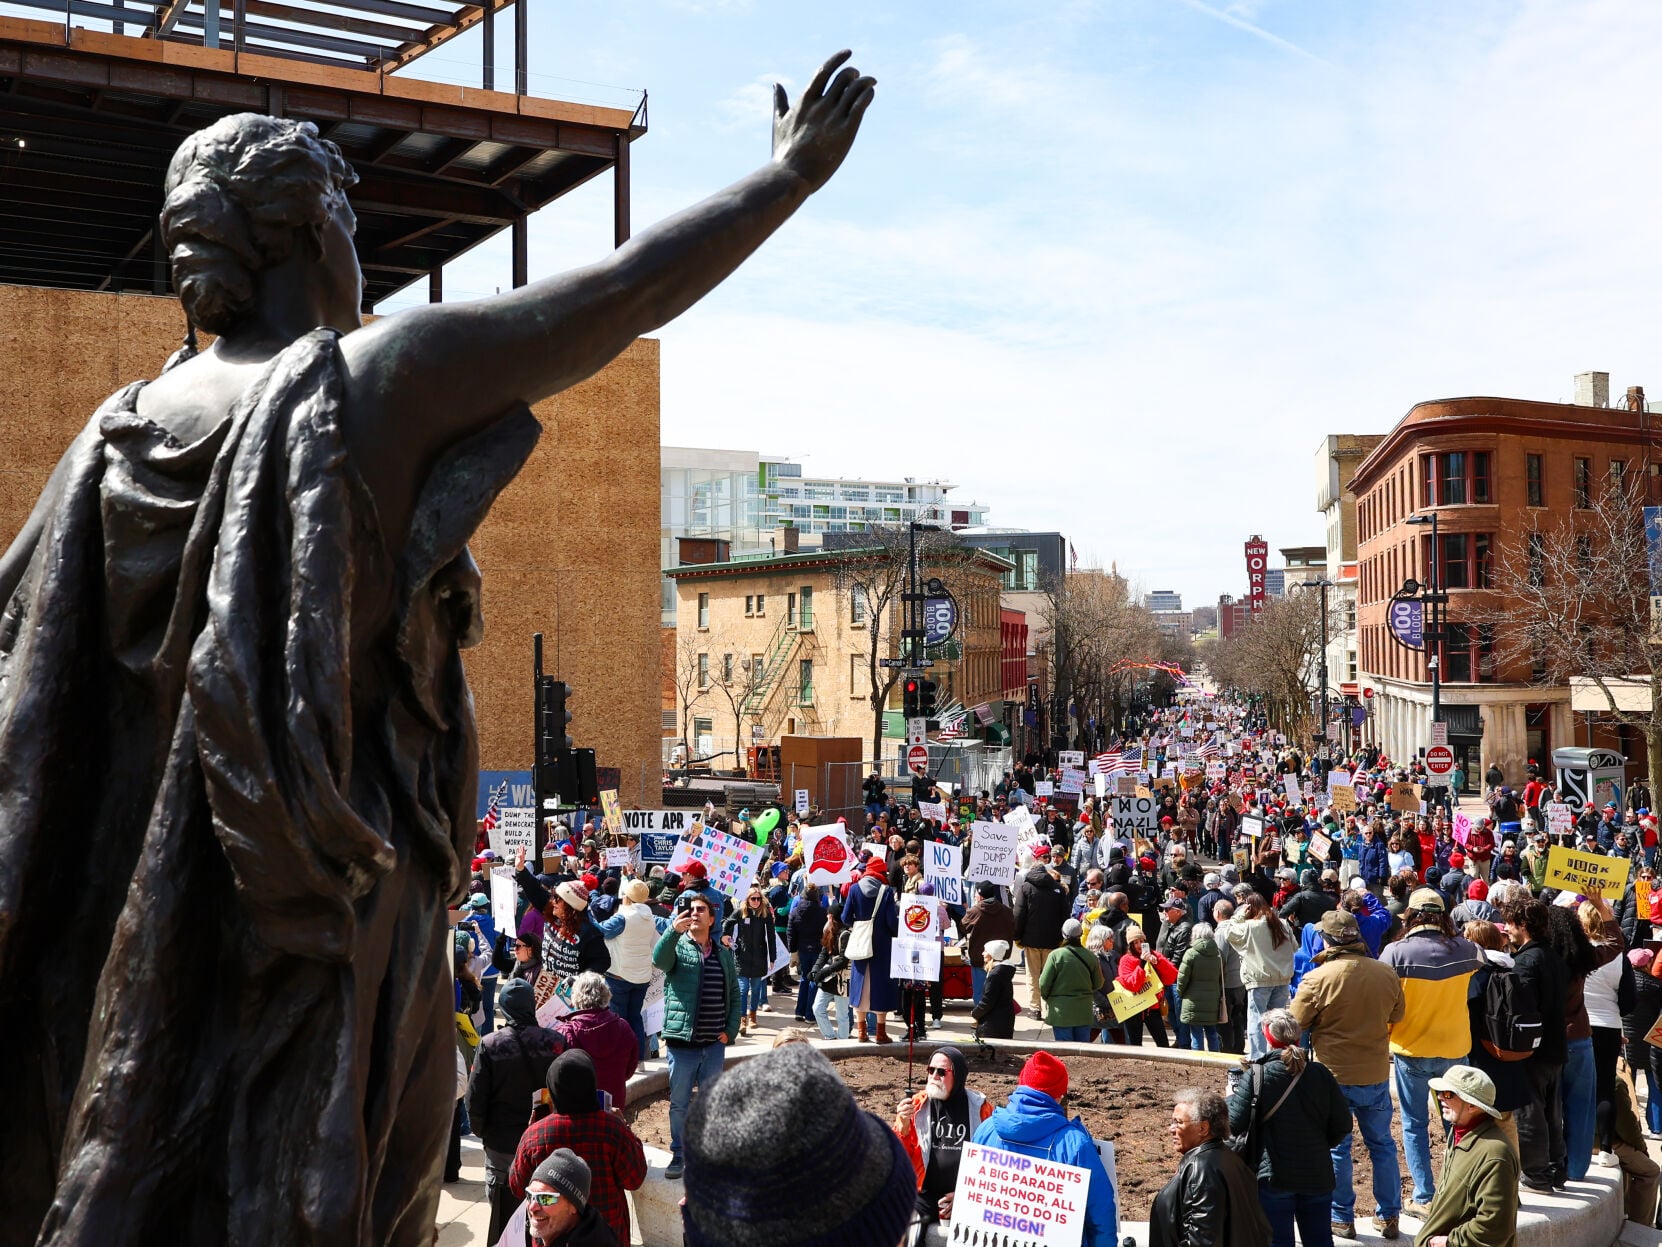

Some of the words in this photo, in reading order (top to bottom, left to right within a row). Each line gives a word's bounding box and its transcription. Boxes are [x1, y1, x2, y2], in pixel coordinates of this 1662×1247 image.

[927, 606, 936, 635] BLOCK
[935, 600, 951, 635] 100
[1395, 603, 1411, 640] 100
[1412, 609, 1421, 639] BLOCK
[1118, 798, 1151, 813] NO
[624, 812, 654, 828] VOTE
[662, 813, 684, 829] APR
[1113, 817, 1150, 828] NAZI
[1455, 814, 1468, 828] NO
[504, 839, 533, 847] WORKERS
[703, 827, 732, 843] DON'T
[980, 825, 1008, 842] Save
[706, 840, 749, 864] NOTHING
[933, 845, 951, 868] NO
[983, 852, 1007, 863] DUMP
[966, 1148, 977, 1159] IF
[980, 1148, 1032, 1172] TRUMP
[1034, 1163, 1082, 1184] WANTS
[978, 1166, 986, 1175] A
[989, 1167, 1010, 1181] BIG
[1012, 1172, 1064, 1195] PARADE
[964, 1175, 976, 1187] IN
[978, 1180, 997, 1193] HIS
[1000, 1185, 1048, 1208] HONOR,
[1051, 1199, 1076, 1212] ALL
[967, 1191, 983, 1204] HE
[985, 1194, 1010, 1211] HAS
[1013, 1202, 1030, 1215] TO
[1033, 1206, 1051, 1221] DO
[1055, 1212, 1068, 1225] IS
[982, 1209, 1046, 1237] RESIGN!
